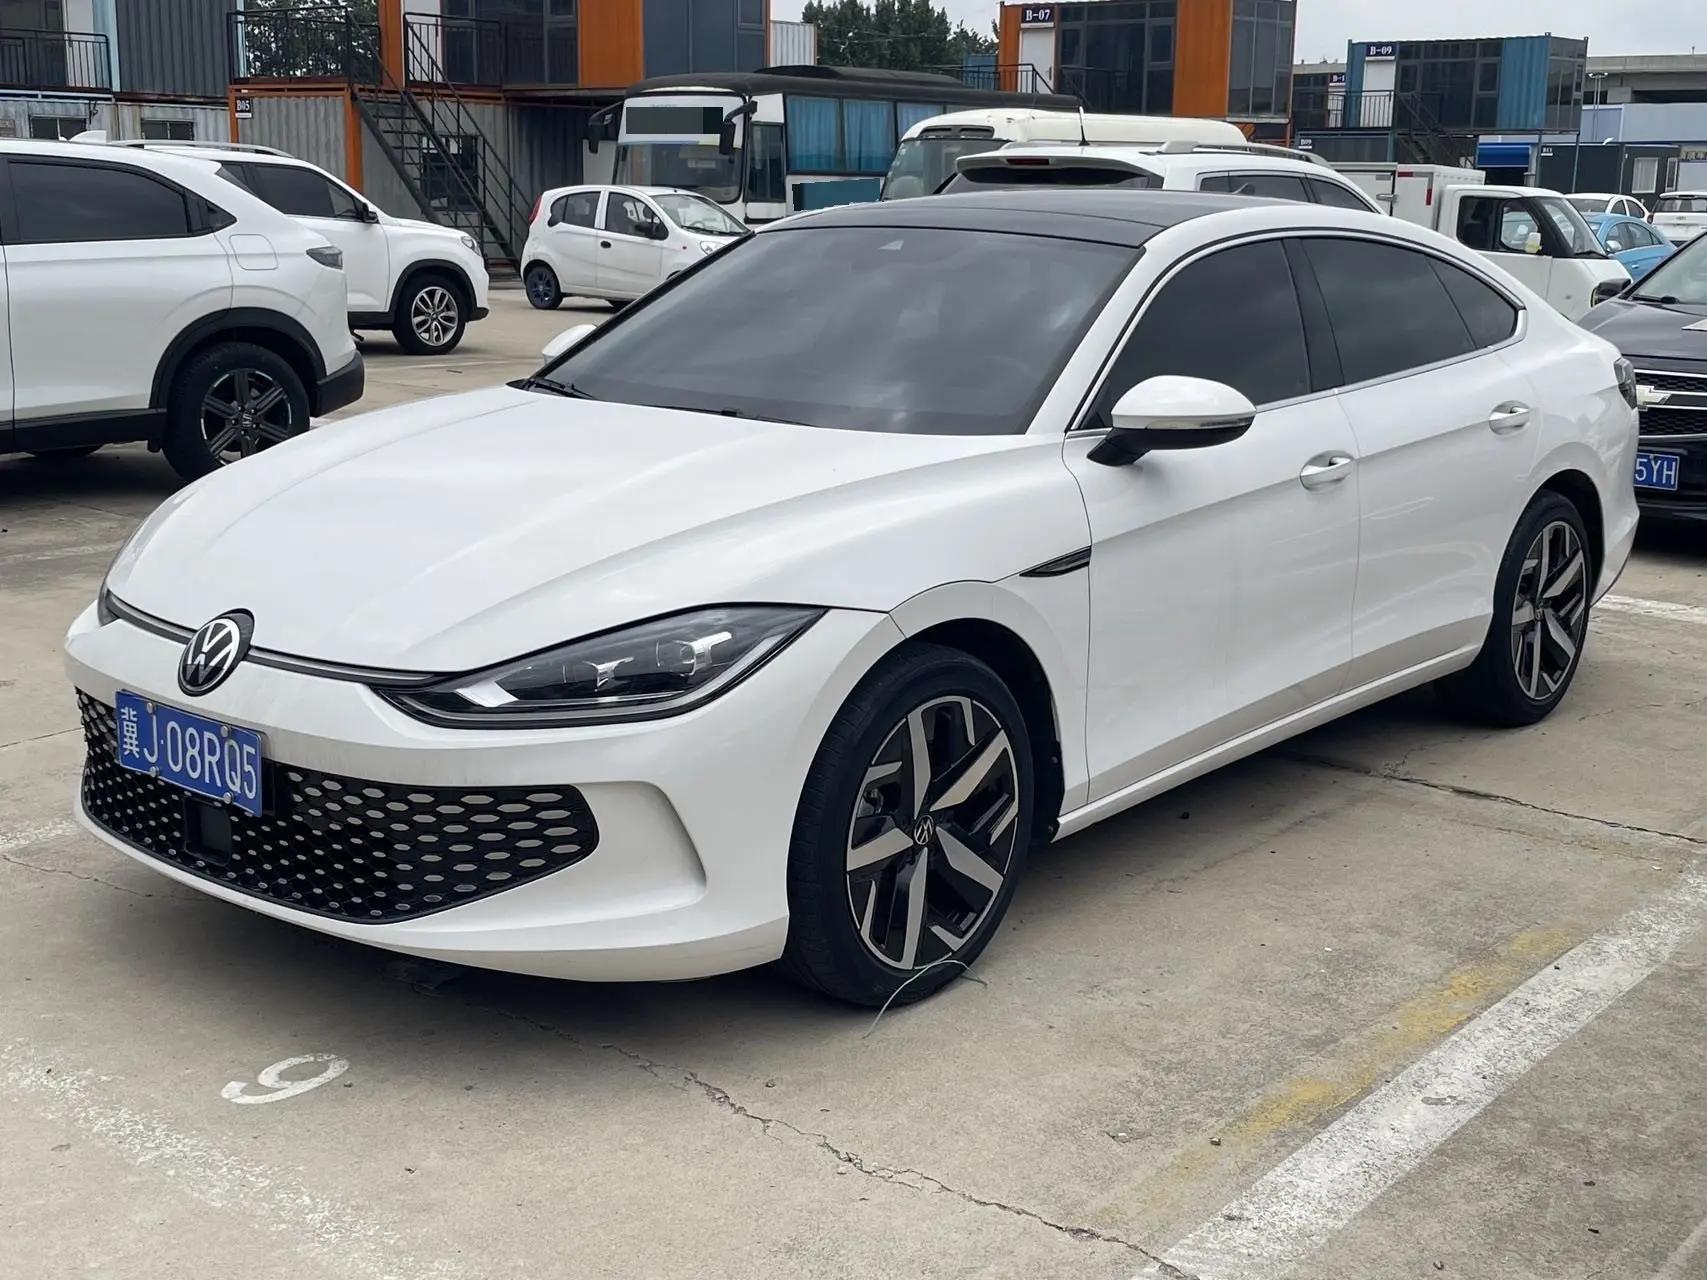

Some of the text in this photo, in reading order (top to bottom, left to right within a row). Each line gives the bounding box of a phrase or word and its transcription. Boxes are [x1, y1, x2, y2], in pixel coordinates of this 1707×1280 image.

[1025, 9, 1050, 21] B-07
[1370, 45, 1392, 55] B-09
[236, 99, 250, 111] B05
[1635, 458, 1676, 485] 5YH
